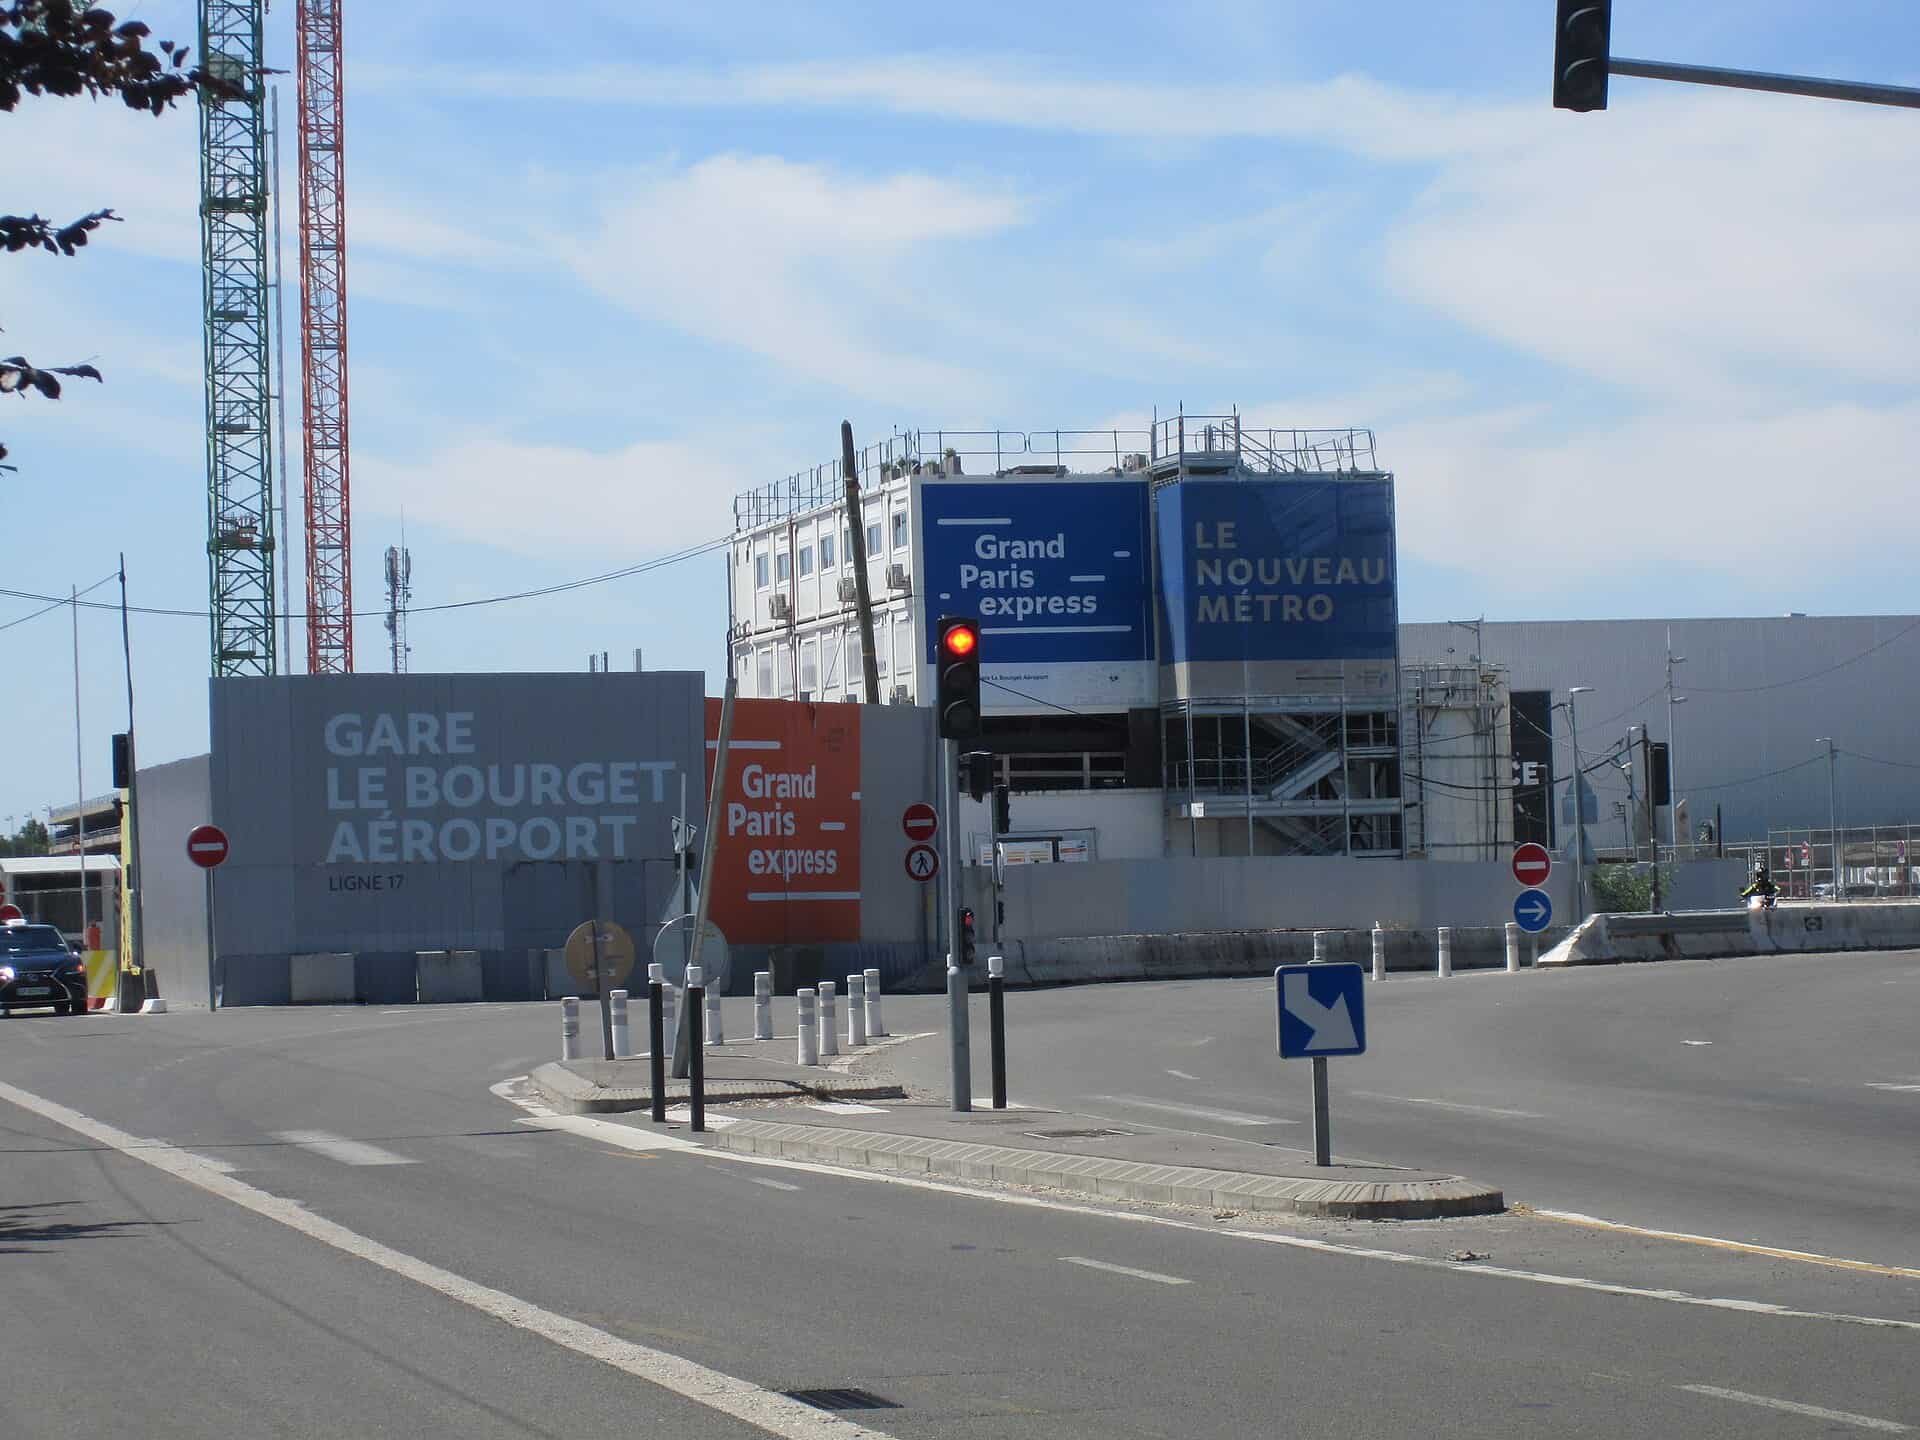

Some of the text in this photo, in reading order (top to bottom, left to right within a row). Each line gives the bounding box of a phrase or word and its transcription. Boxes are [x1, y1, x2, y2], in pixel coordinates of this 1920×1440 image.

[974, 533, 1066, 560] Grand
[1195, 521, 1238, 549] LE
[959, 563, 1035, 589] Paris
[1196, 557, 1387, 586] NOUVEAU
[979, 594, 1098, 622] express
[1197, 588, 1335, 623] MÉTRO
[324, 711, 476, 756] GARE
[326, 761, 677, 810] LE BOURGET
[741, 763, 817, 799] Grand
[325, 810, 638, 864] AÉROPORT
[727, 802, 797, 837] Paris
[328, 873, 405, 891] LIGNE 17
[748, 848, 838, 883] express
